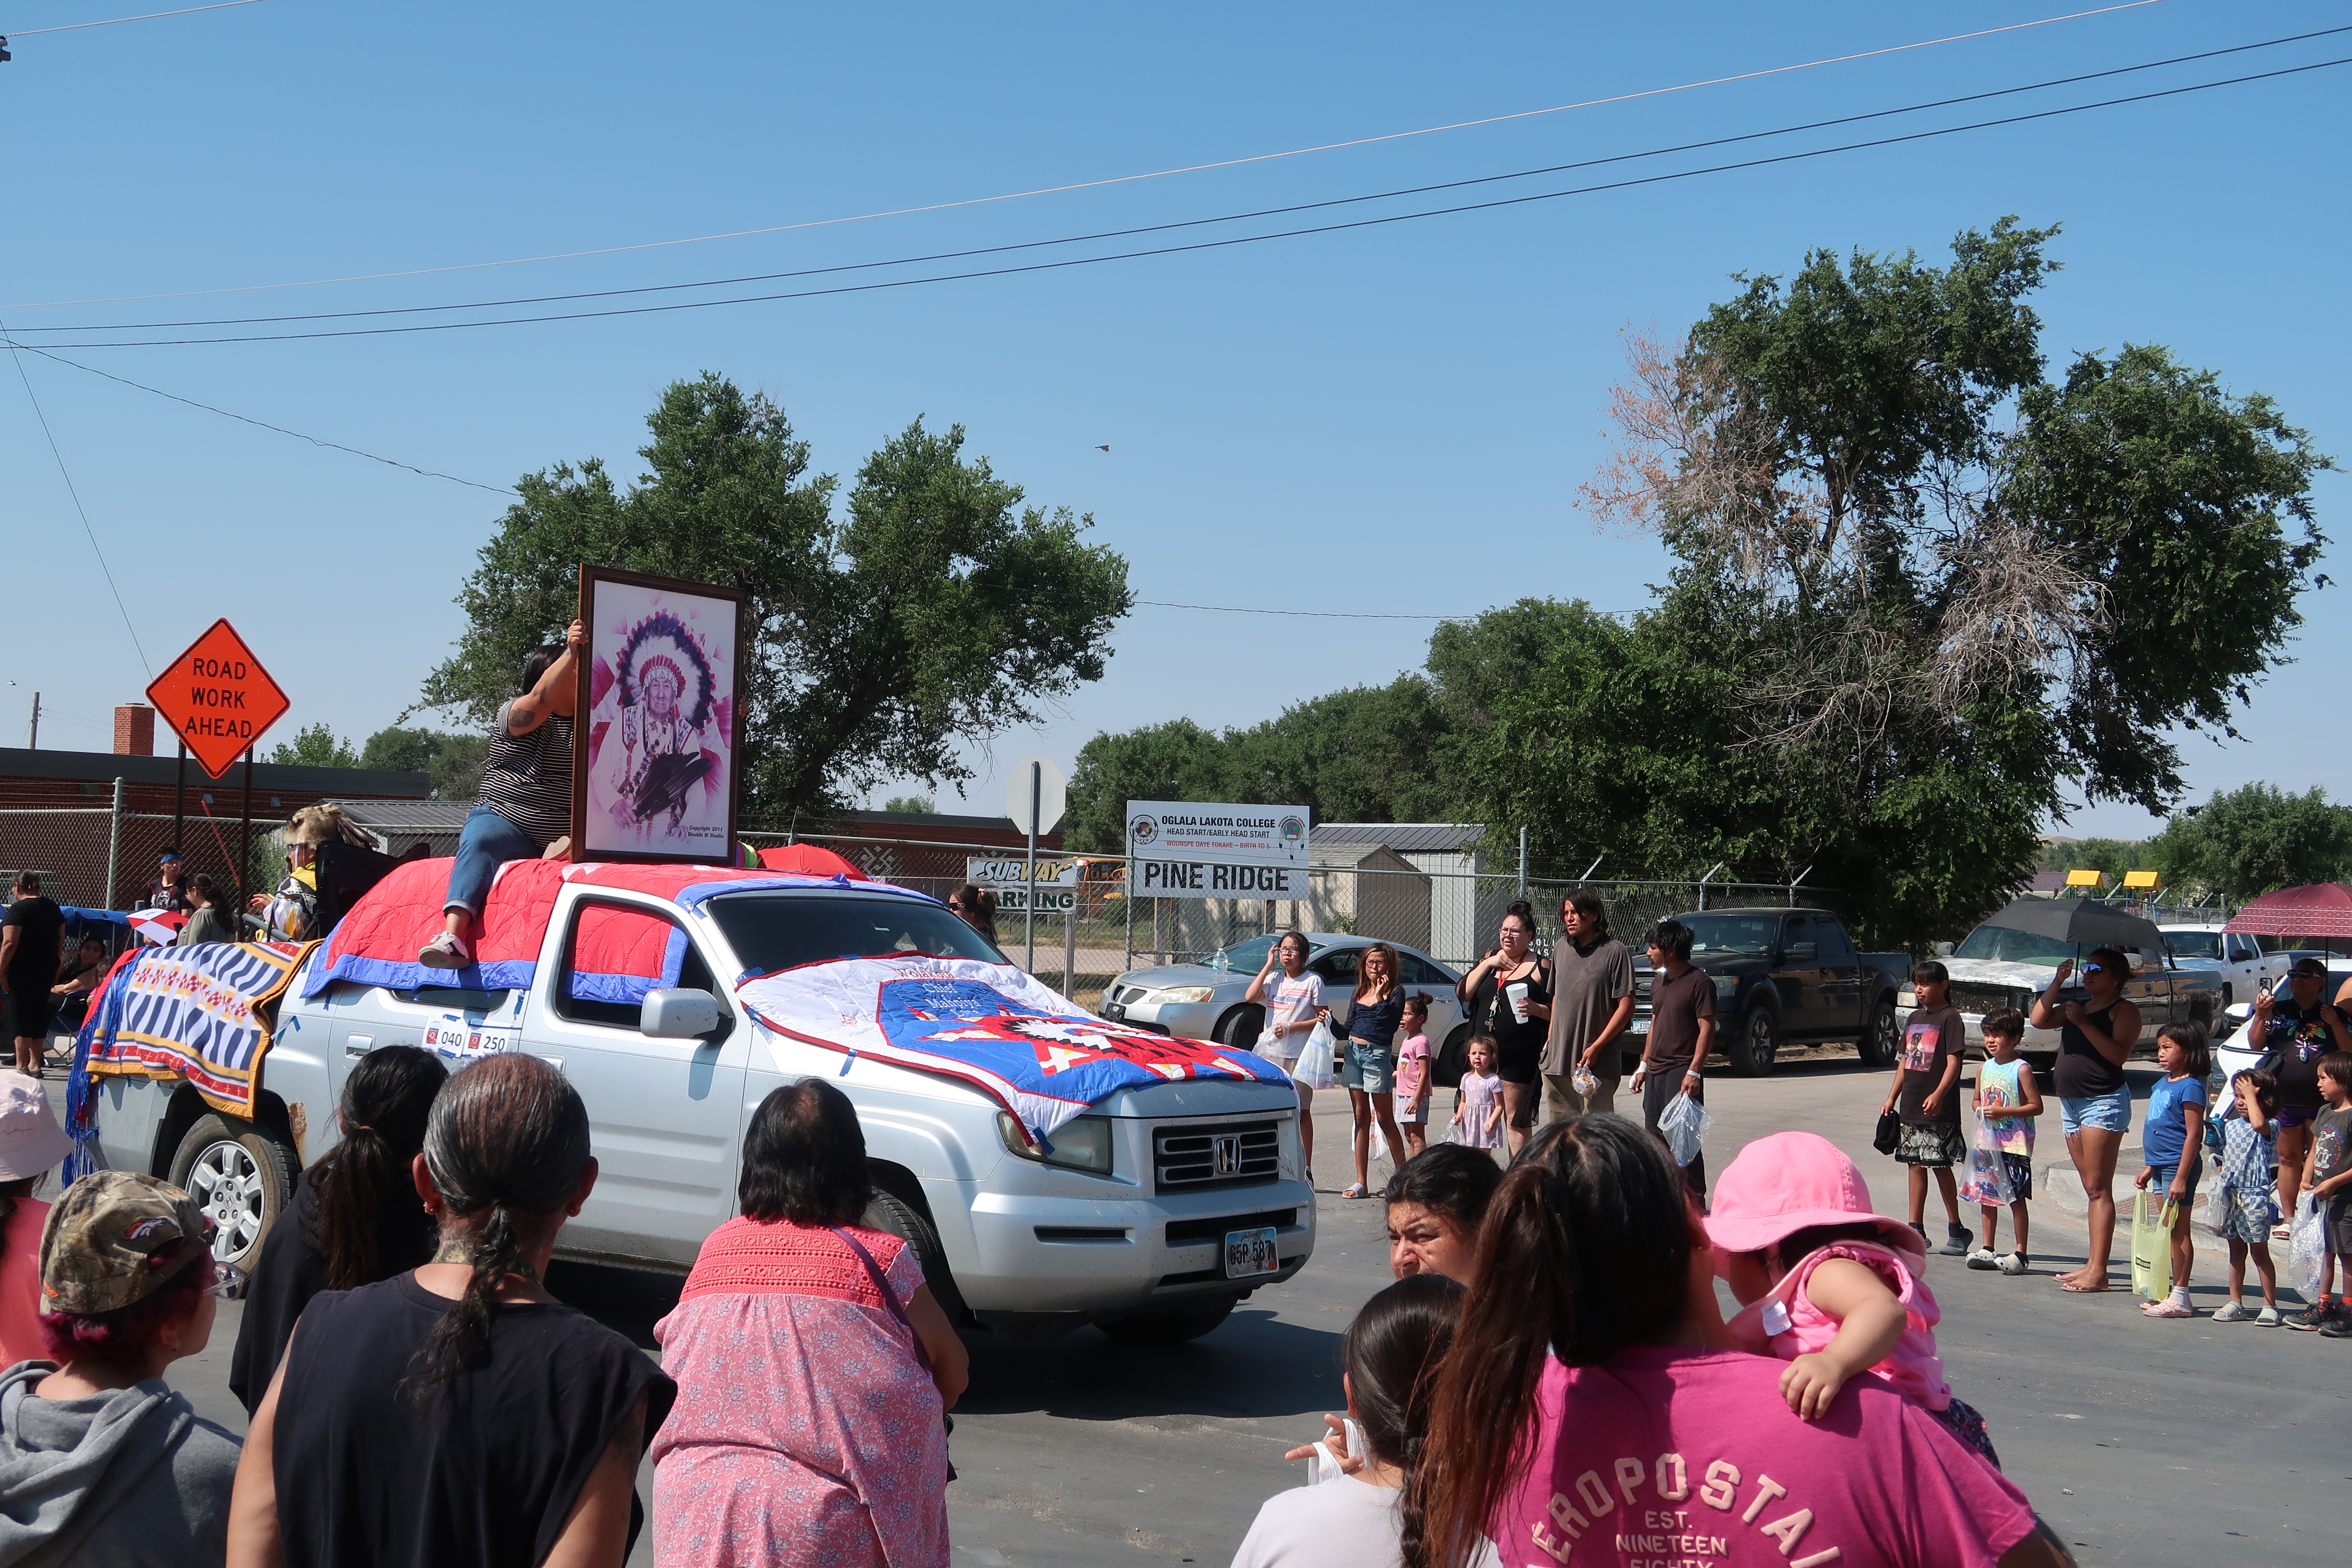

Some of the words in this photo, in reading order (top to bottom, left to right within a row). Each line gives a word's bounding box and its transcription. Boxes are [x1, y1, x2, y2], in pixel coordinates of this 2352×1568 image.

[193, 658, 246, 680] ROAD
[191, 687, 246, 709] WORK
[185, 716, 252, 738] AHEAD
[1161, 815, 1197, 825] OGLALA
[1200, 817, 1234, 827] LAKOTA
[1236, 818, 1275, 828] COLLEGE
[976, 861, 1072, 882] SUBWAY
[1145, 862, 1204, 889] PINE
[1213, 865, 1289, 891] RIDGE
[993, 891, 1073, 908] ARKING
[892, 968, 956, 979] Wolakota
[922, 983, 958, 993] Chief
[441, 1032, 462, 1047] 040
[483, 1035, 505, 1051] 250
[1253, 1240, 1271, 1262] 587
[1645, 1510, 1693, 1529] EST.
[1616, 1534, 1728, 1556] NINETEEN
